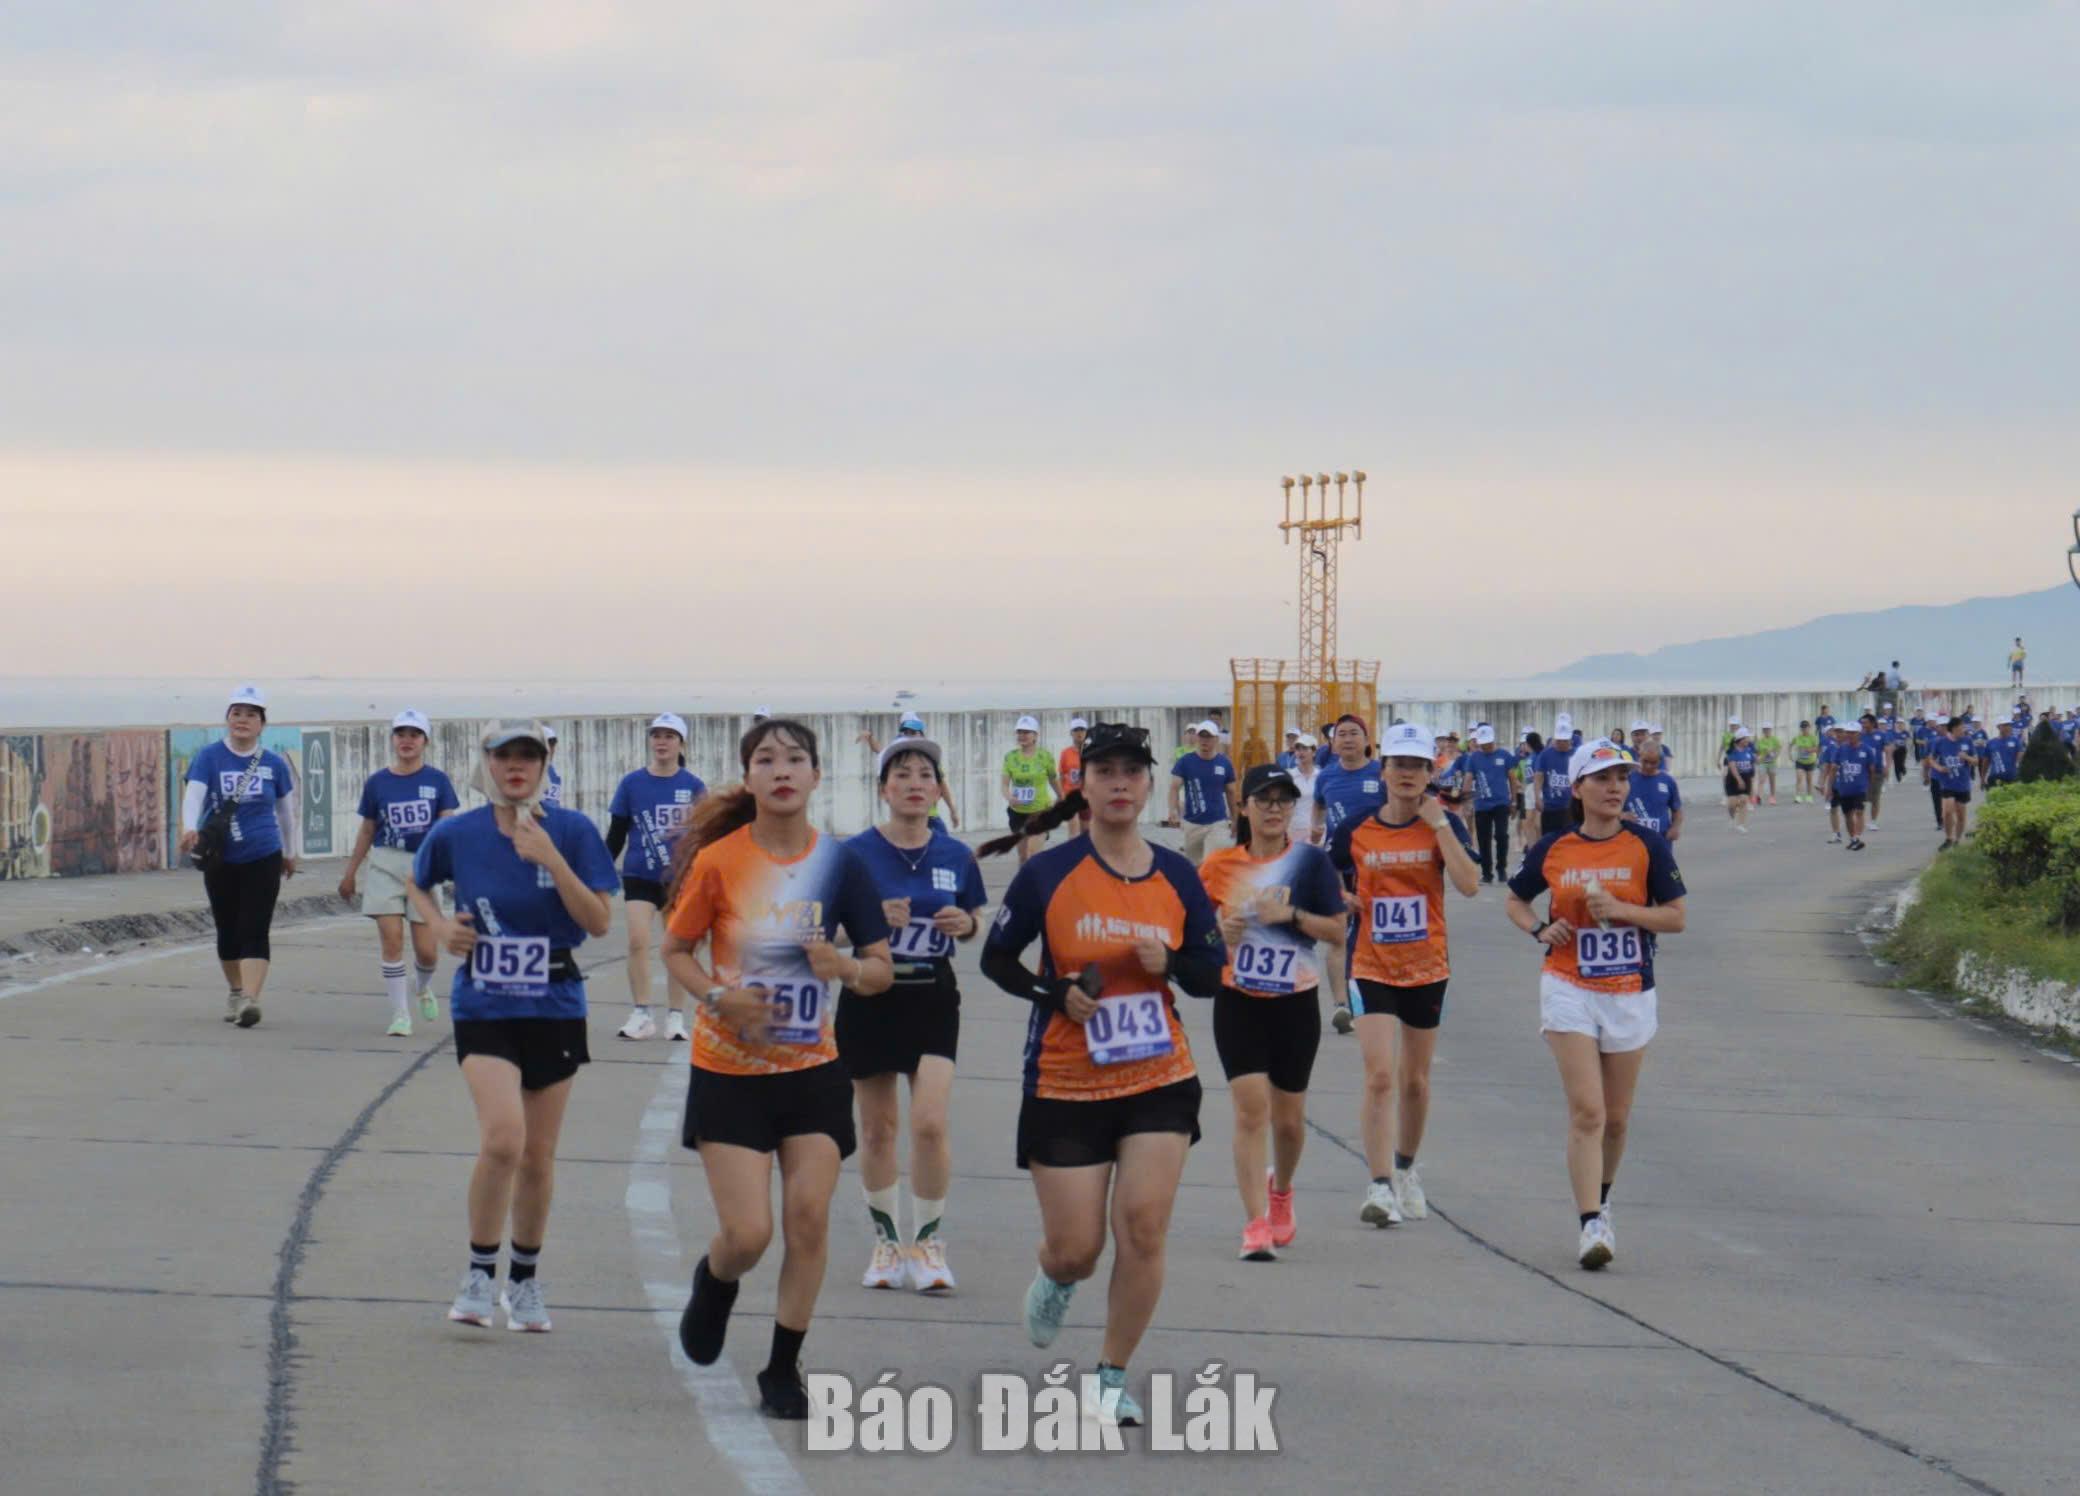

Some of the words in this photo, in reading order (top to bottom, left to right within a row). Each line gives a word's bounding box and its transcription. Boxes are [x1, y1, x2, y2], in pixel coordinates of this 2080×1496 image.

[390, 803, 429, 825] 565
[658, 807, 691, 826] 59
[1375, 900, 1421, 929] 041
[475, 941, 545, 977] 052
[1237, 943, 1295, 977] 037
[1580, 931, 1637, 961] 036
[746, 981, 819, 1022] 50
[1089, 998, 1163, 1043] 043
